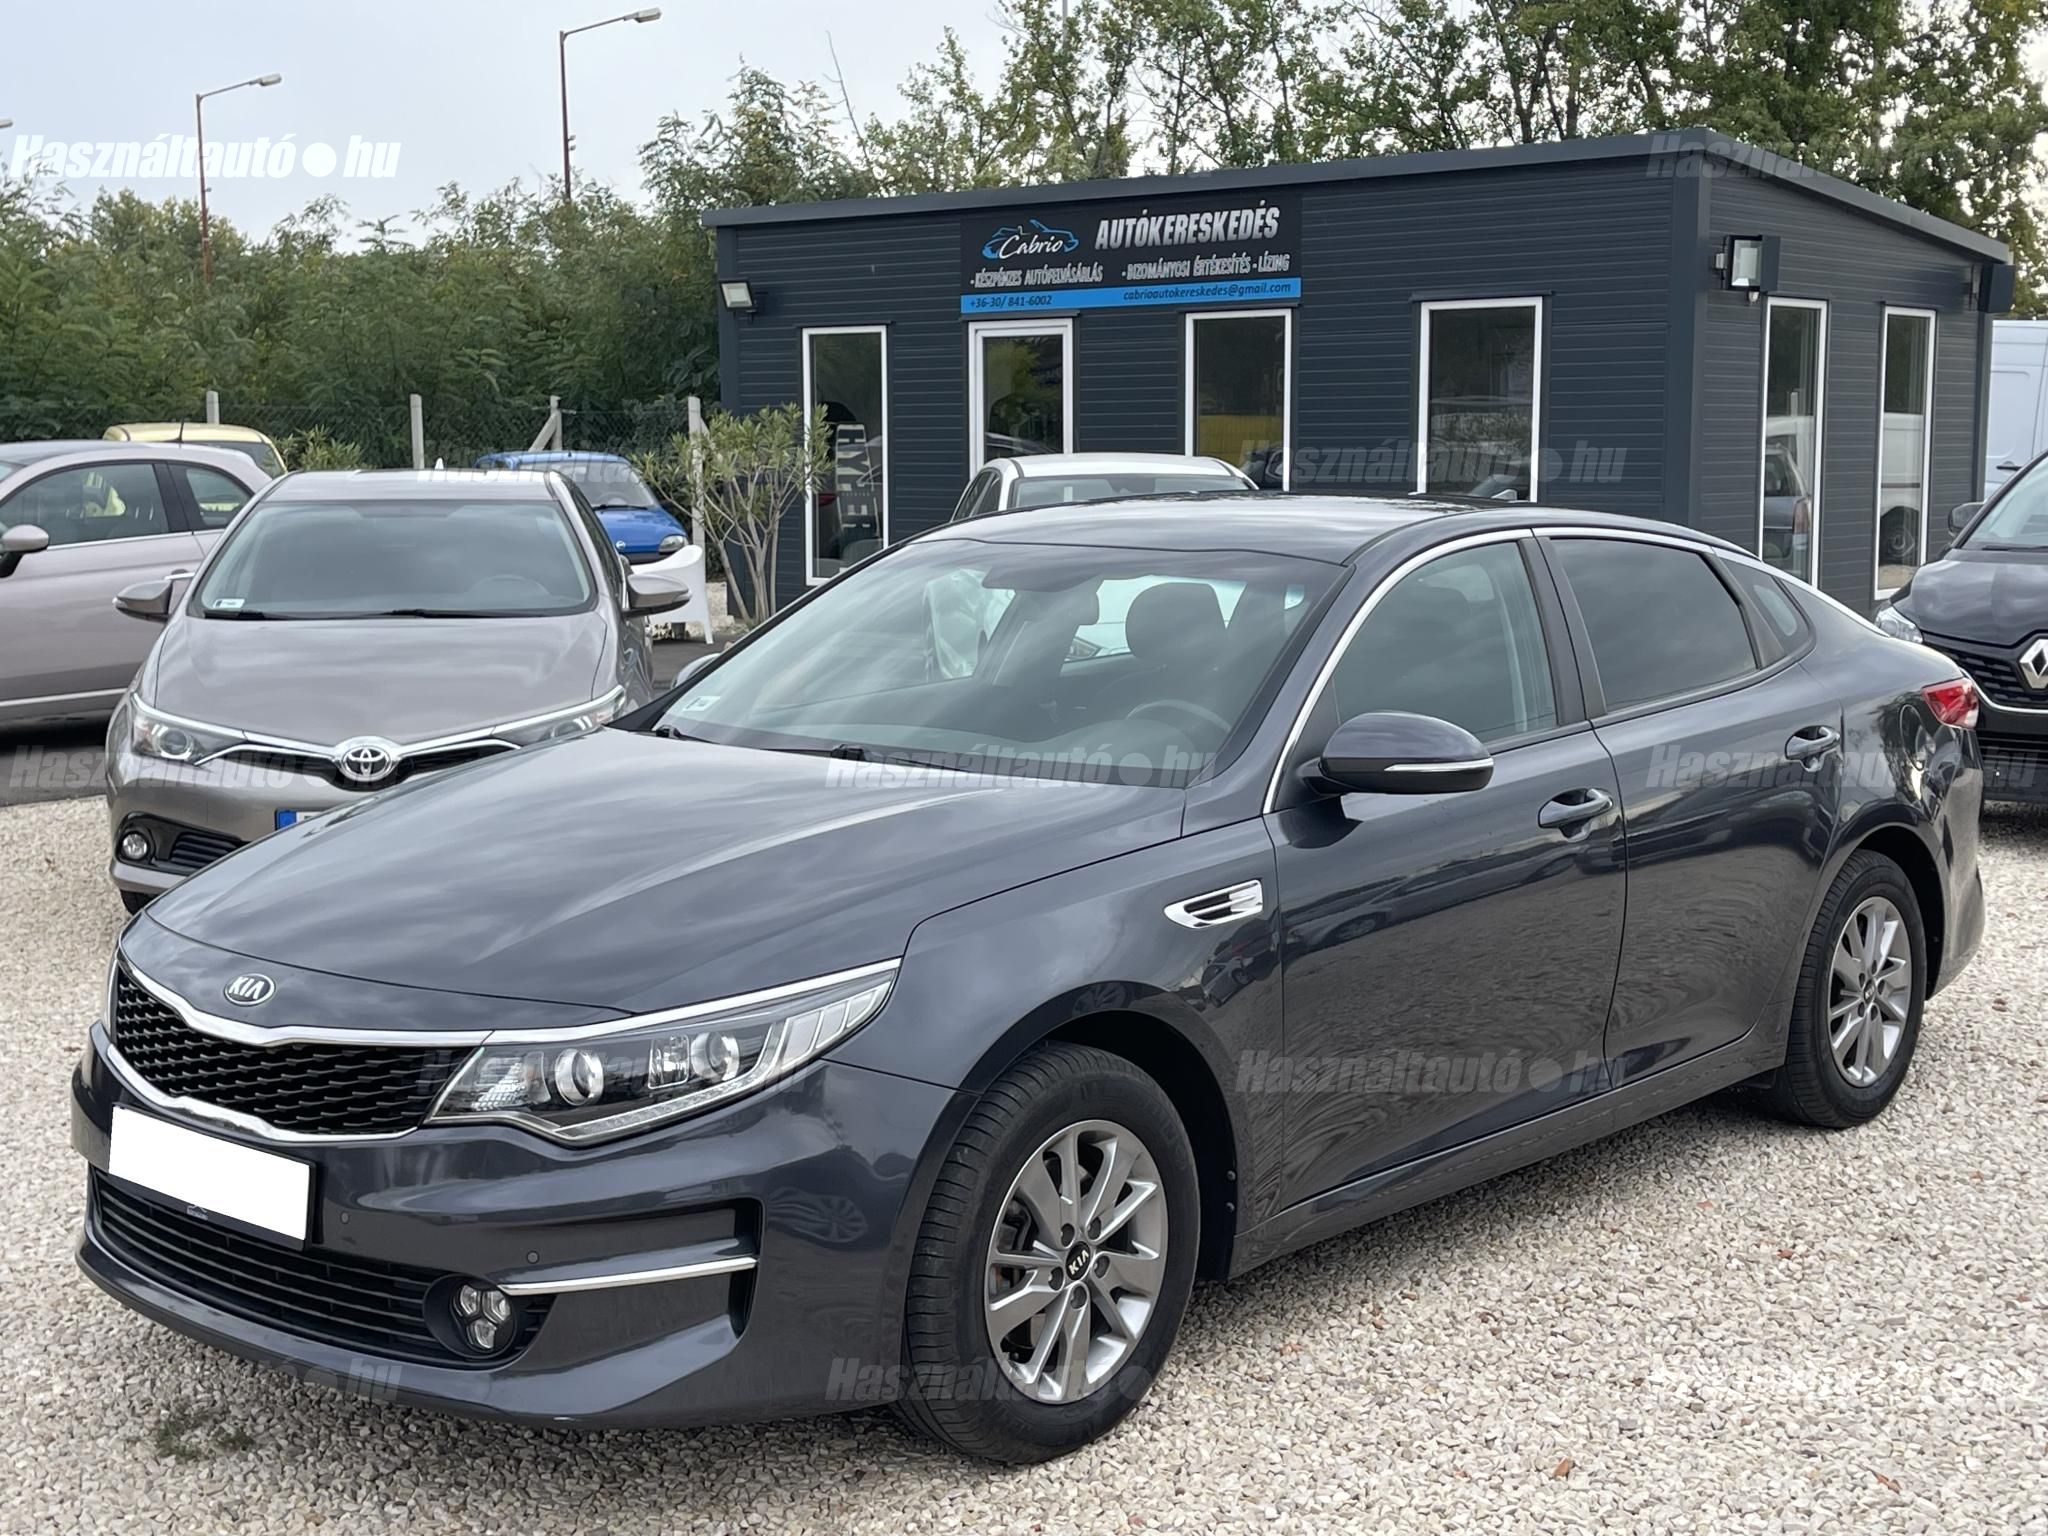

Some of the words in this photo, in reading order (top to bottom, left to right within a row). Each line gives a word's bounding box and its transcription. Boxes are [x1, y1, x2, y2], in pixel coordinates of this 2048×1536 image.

[1095, 200, 1280, 250] AUTÓKERESKEDÉS
[1000, 234, 1064, 259] Cabrio
[1123, 282, 1292, 301] cabrioautokereskedes@gmail.com
[228, 976, 265, 999] KIA
[1068, 1249, 1089, 1275] KIA
